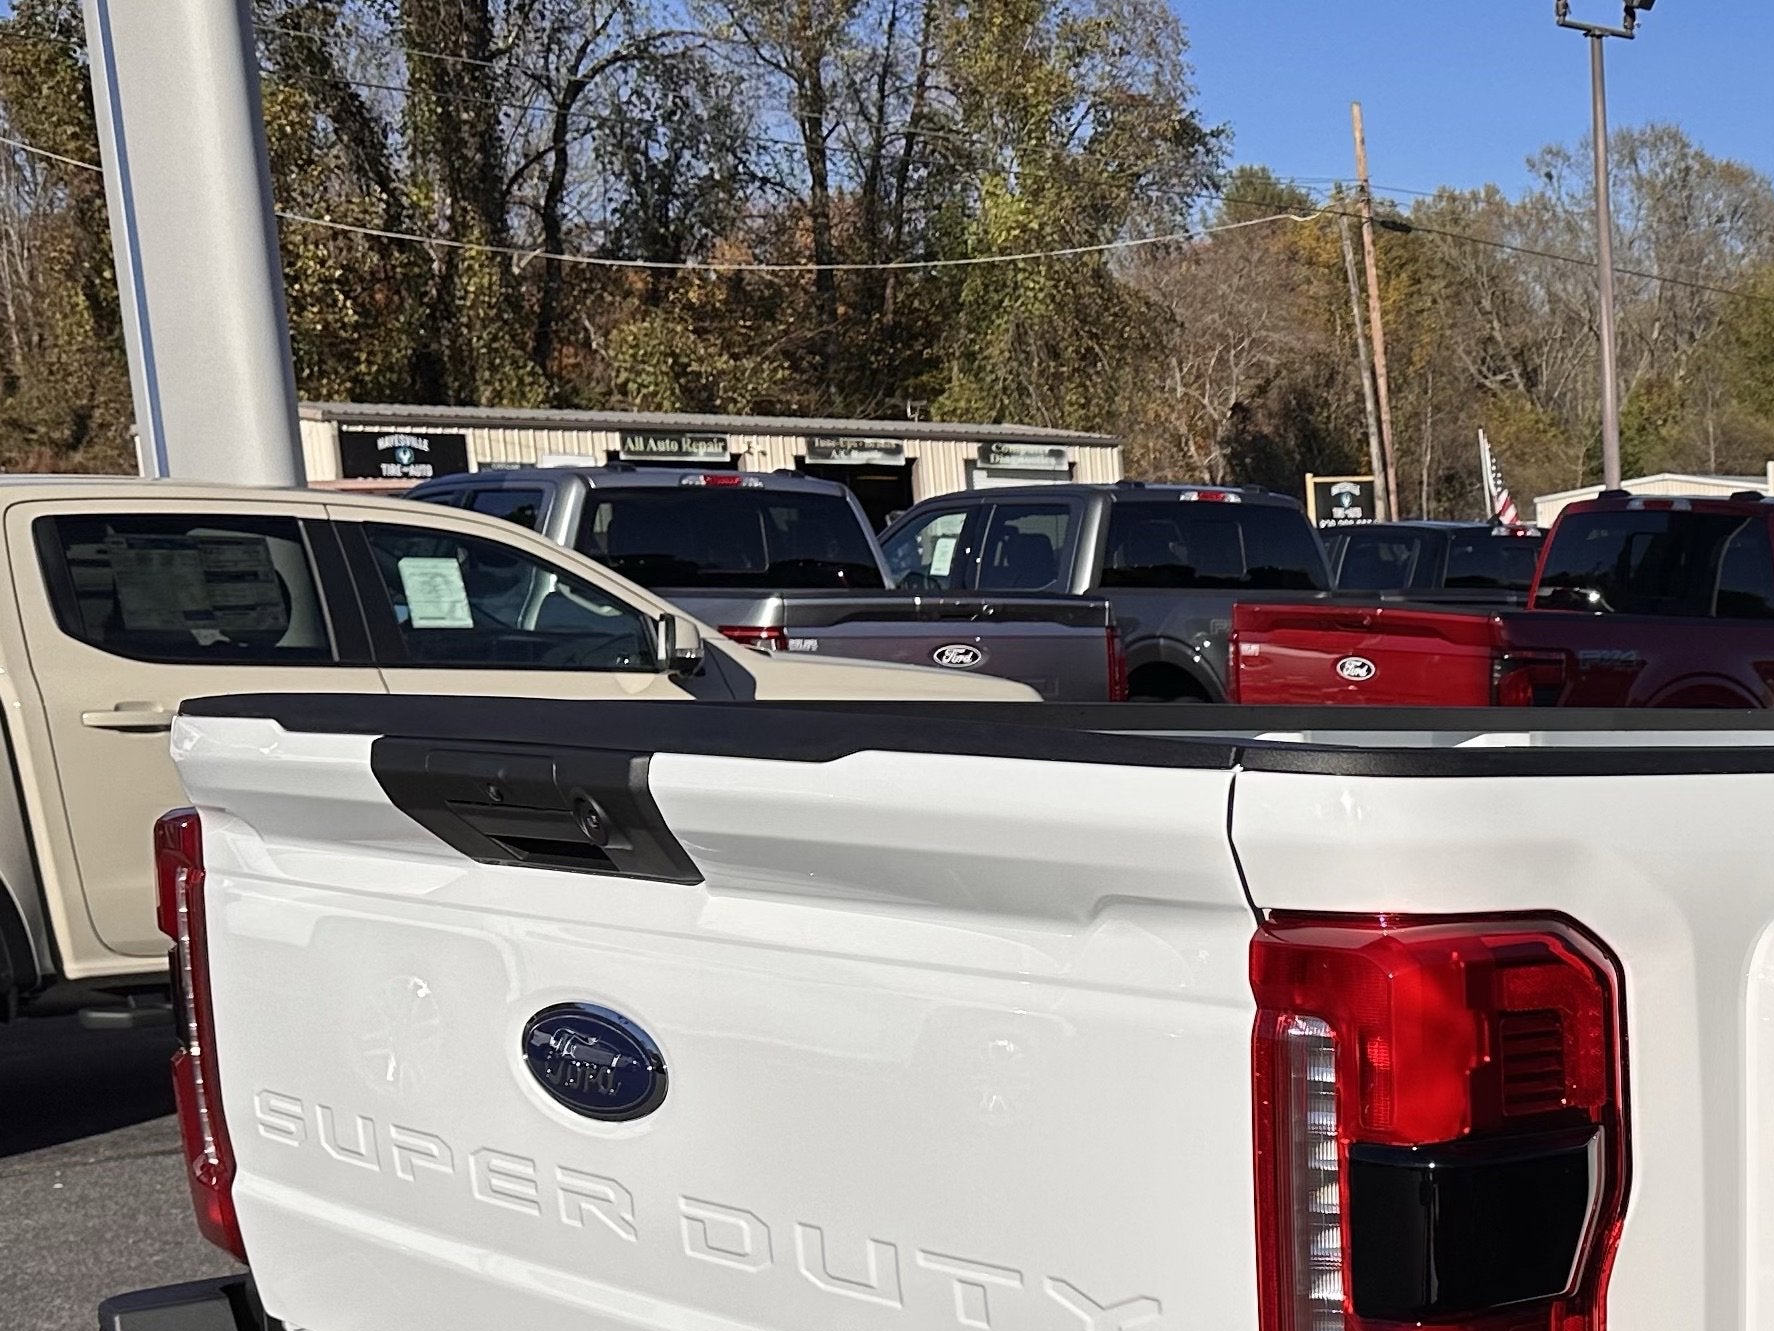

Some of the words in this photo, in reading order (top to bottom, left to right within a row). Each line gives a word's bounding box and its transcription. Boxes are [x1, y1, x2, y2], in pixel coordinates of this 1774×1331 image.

[624, 435, 645, 452] All
[646, 437, 679, 452] Auto
[682, 437, 726, 456] Repair
[252, 1088, 637, 1243] SUPER
